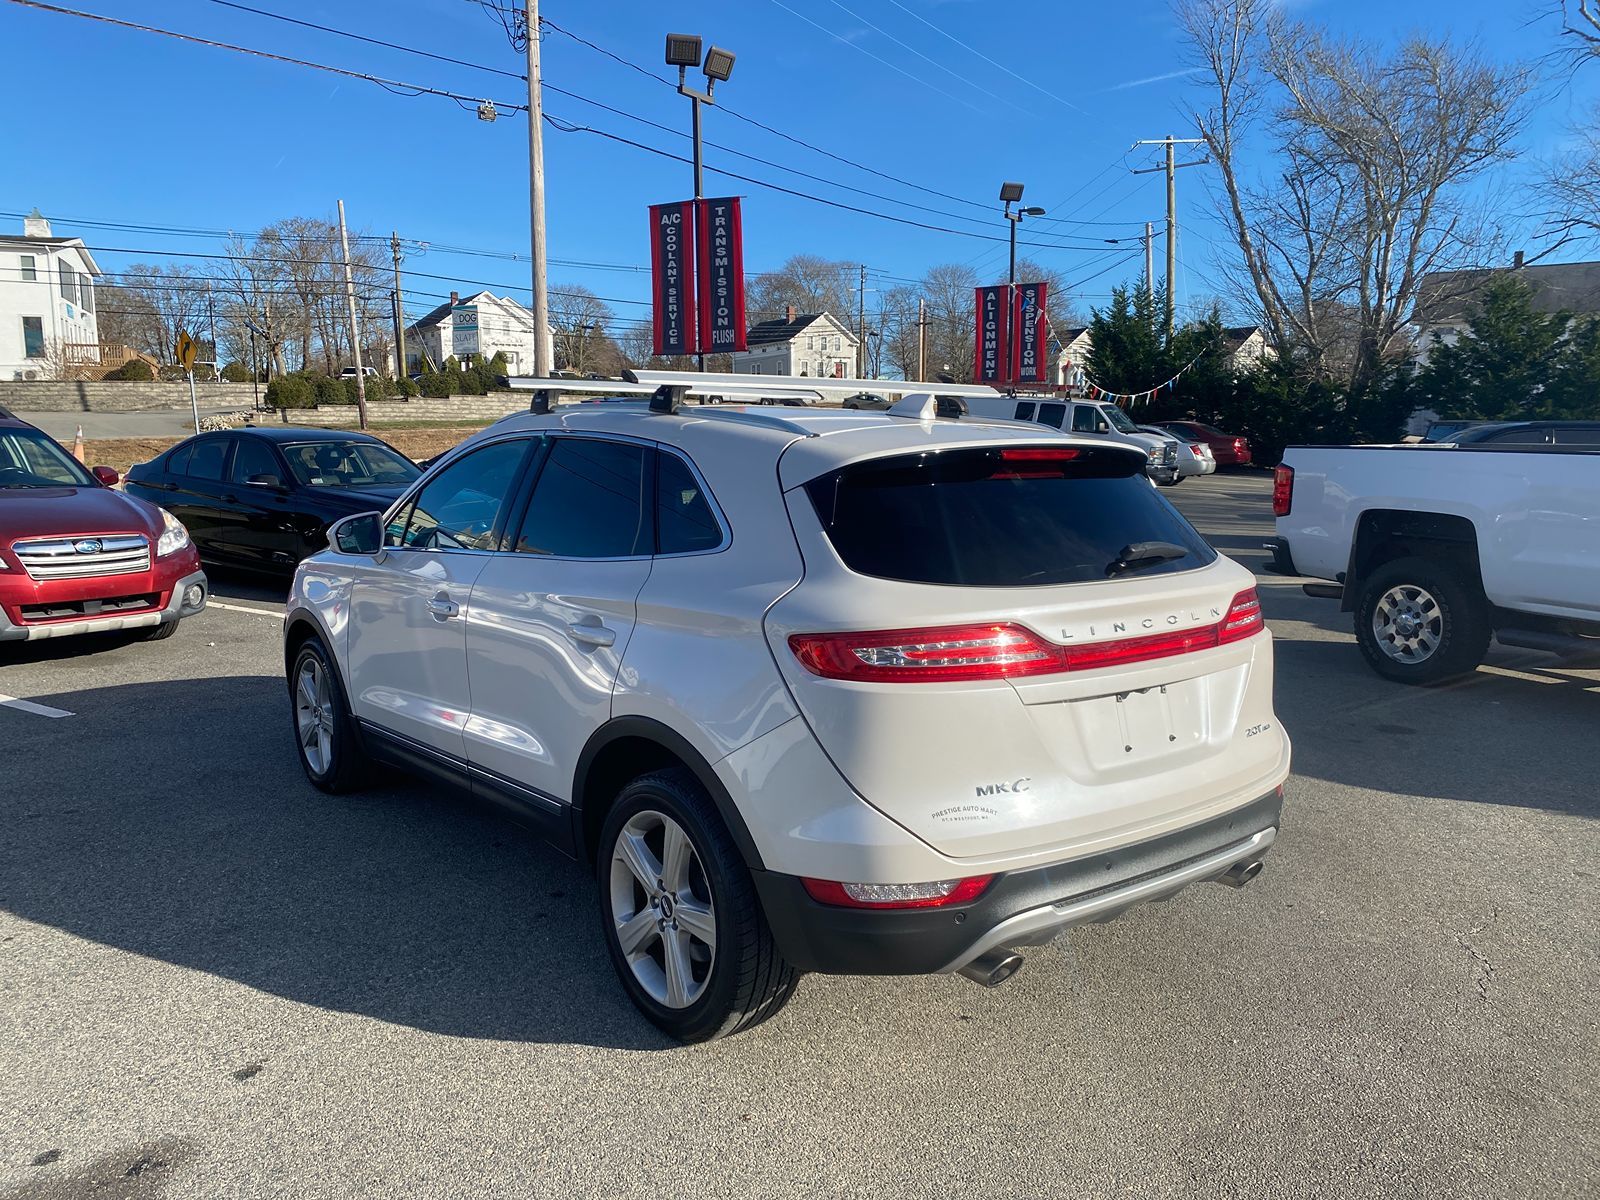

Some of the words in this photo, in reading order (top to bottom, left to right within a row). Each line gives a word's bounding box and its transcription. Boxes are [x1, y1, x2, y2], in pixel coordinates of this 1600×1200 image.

[661, 213, 681, 225] A/C
[667, 226, 677, 284] COOLANT
[715, 206, 728, 325] TRANSMISSION
[459, 313, 477, 323] DOG
[668, 287, 678, 345] SERVICE
[712, 328, 735, 344] FLUSH
[985, 292, 996, 377] ALIGNMENT
[1021, 366, 1036, 375] WORK
[1061, 607, 1220, 639] LINCOLN
[976, 777, 1032, 796] MKC
[931, 806, 961, 819] PRESTIGE
[980, 806, 998, 816] MART
